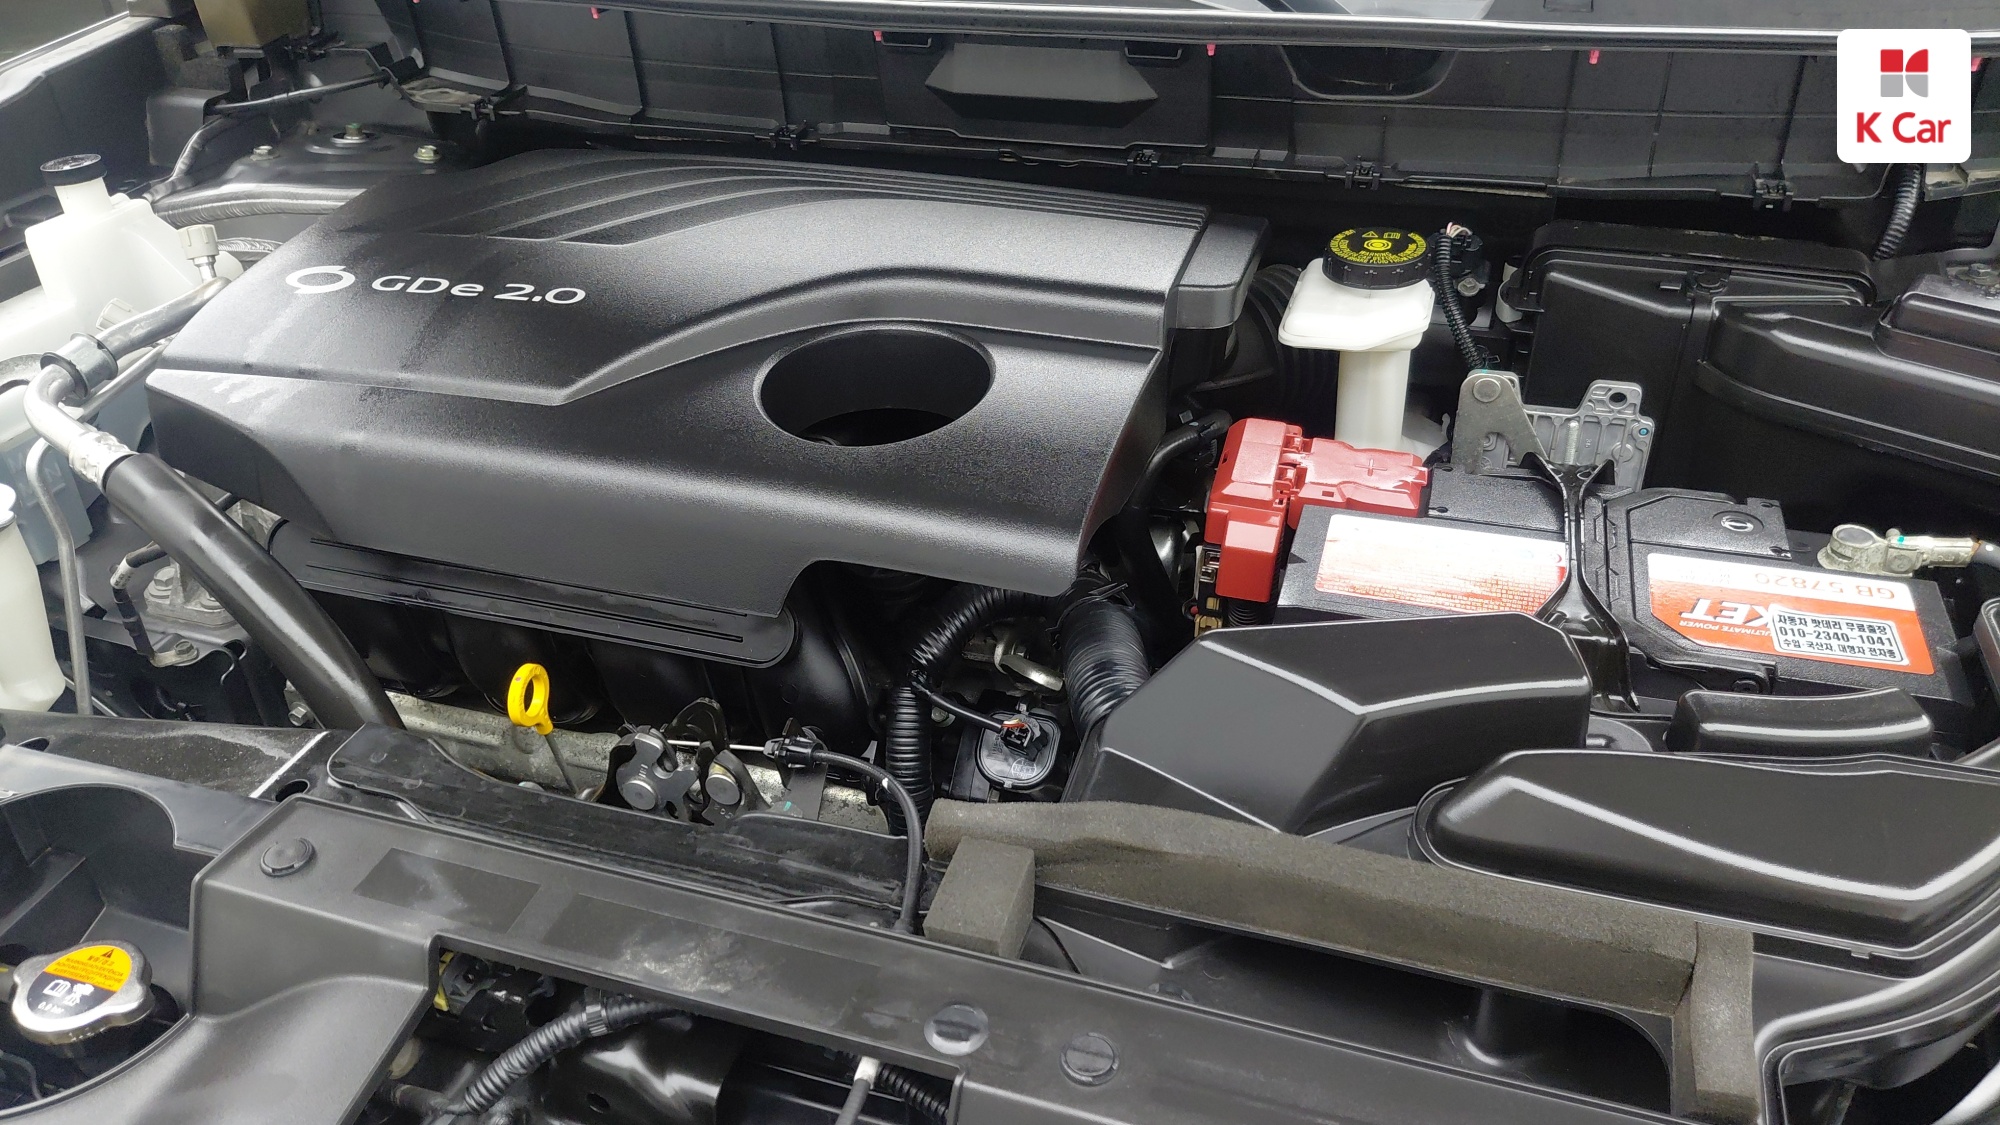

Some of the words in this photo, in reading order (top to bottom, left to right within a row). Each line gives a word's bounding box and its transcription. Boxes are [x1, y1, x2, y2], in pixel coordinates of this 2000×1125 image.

[371, 275, 484, 297] GDe
[493, 283, 586, 304] 2.0
[1857, 583, 1895, 600] GB
[1678, 598, 1770, 628] KET
[1679, 620, 1720, 631] POWER
[1777, 614, 1808, 628] 자동차
[1811, 618, 1842, 631] 밧데리
[1845, 622, 1888, 636] 무료출장
[1779, 626, 1894, 647] 010-2340-1041
